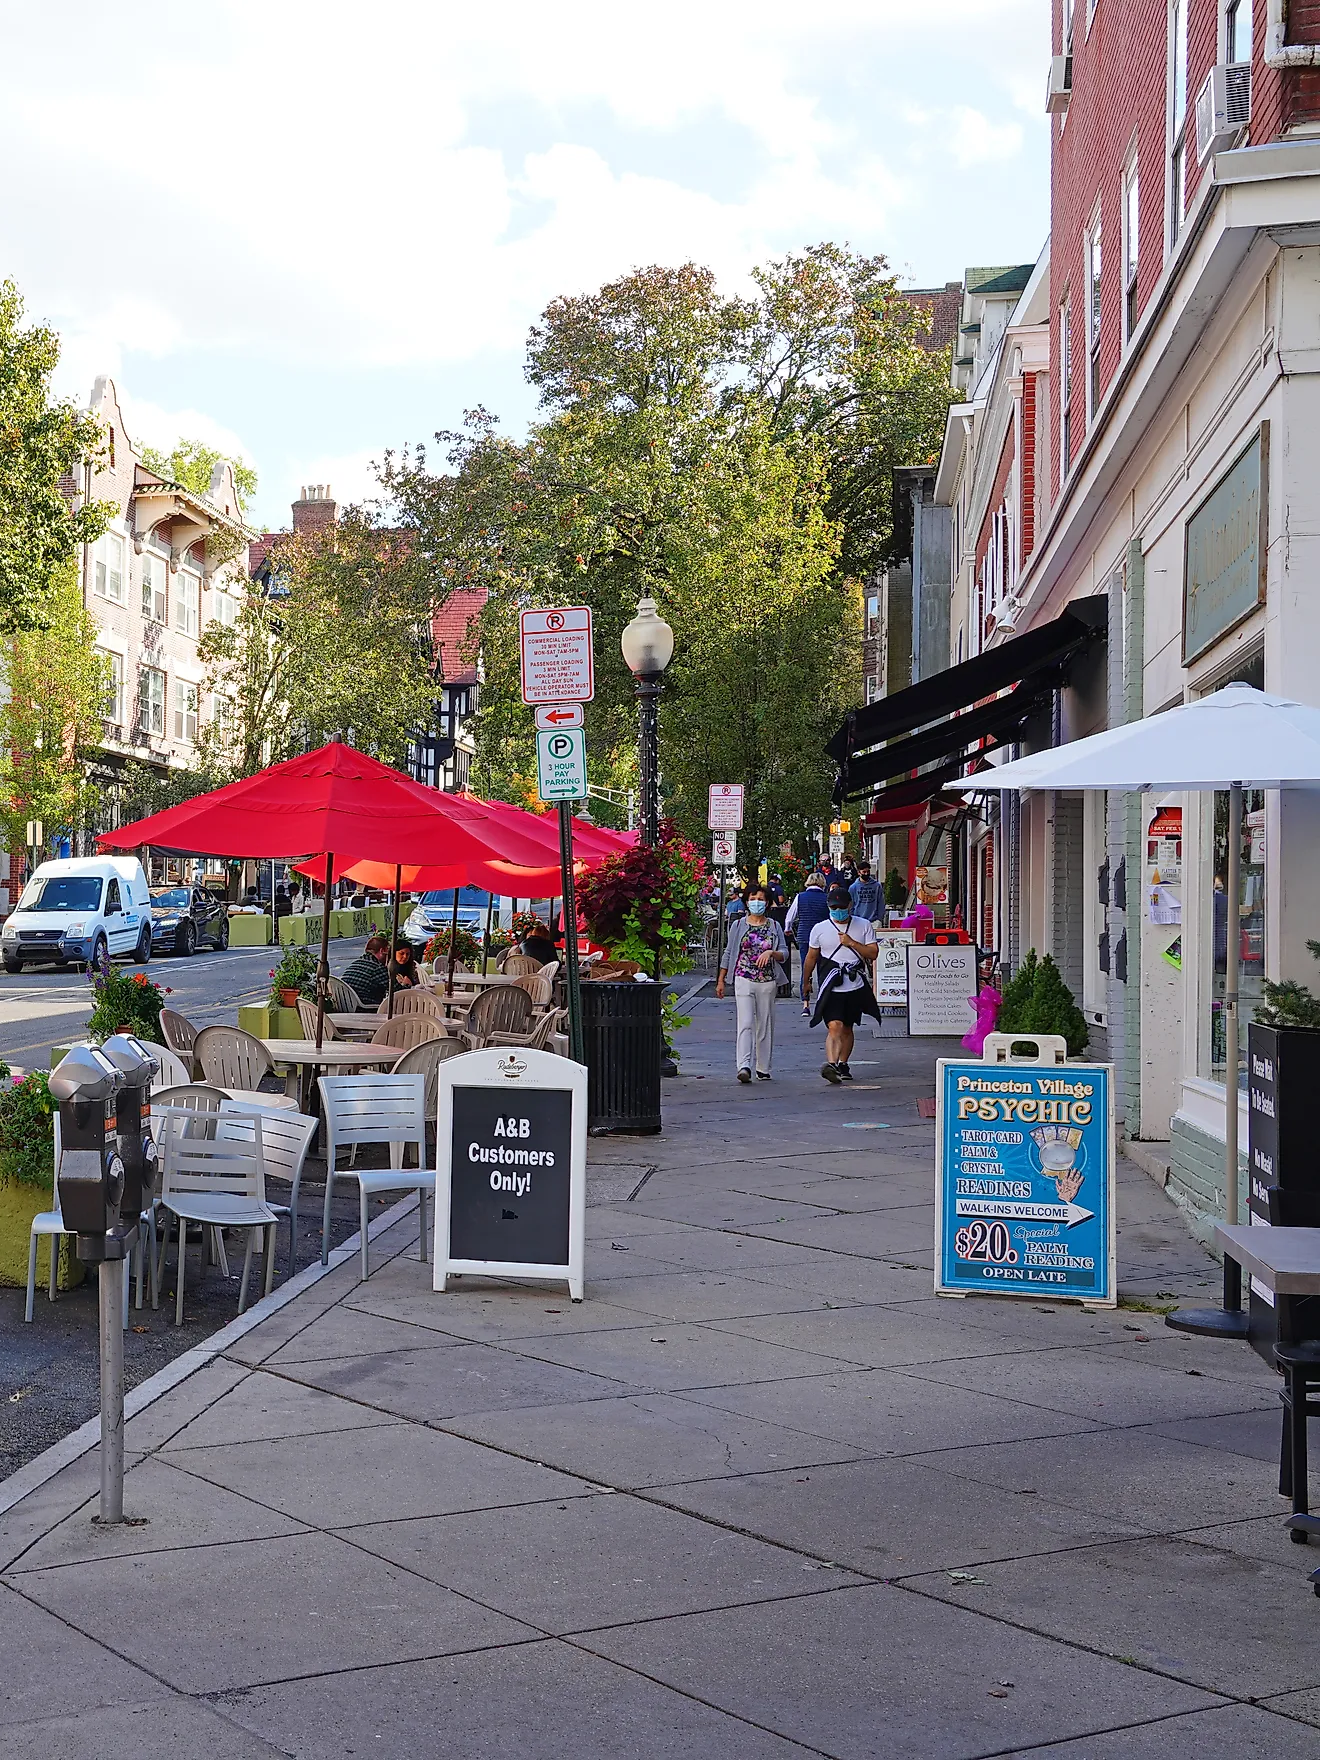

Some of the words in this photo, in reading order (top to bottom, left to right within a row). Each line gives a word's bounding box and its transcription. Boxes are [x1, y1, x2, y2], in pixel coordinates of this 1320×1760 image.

[554, 739, 567, 754] P
[917, 953, 966, 969] Olives
[1252, 1053, 1264, 1078] Please
[1264, 1057, 1273, 1082] Wait
[957, 1076, 1032, 1094] Princeton
[1036, 1078, 1094, 1099] Village
[1251, 1086, 1256, 1108] To
[1256, 1090, 1261, 1111] Be
[957, 1096, 1092, 1125] PSYCHIC
[494, 1117, 530, 1138] A&B
[962, 1130, 994, 1142] TAROT
[995, 1132, 1023, 1144] CARD
[468, 1142, 555, 1166] Customers
[961, 1147, 987, 1158] PALM
[989, 1148, 997, 1158] &
[1254, 1148, 1260, 1167] No
[961, 1163, 1004, 1174] CRYSTAL
[490, 1170, 531, 1196] Only!
[957, 1179, 1032, 1198] READINGS
[1252, 1176, 1258, 1197] No
[960, 1203, 1012, 1214] WALK-INS
[1014, 1206, 1068, 1218] WELCOME
[956, 1220, 1018, 1263] $20.
[1014, 1224, 1060, 1242] Special
[1026, 1242, 1068, 1255] PALM
[1024, 1254, 1094, 1269] READING
[983, 1267, 1024, 1279] OPEN
[1028, 1270, 1066, 1282] LATE
